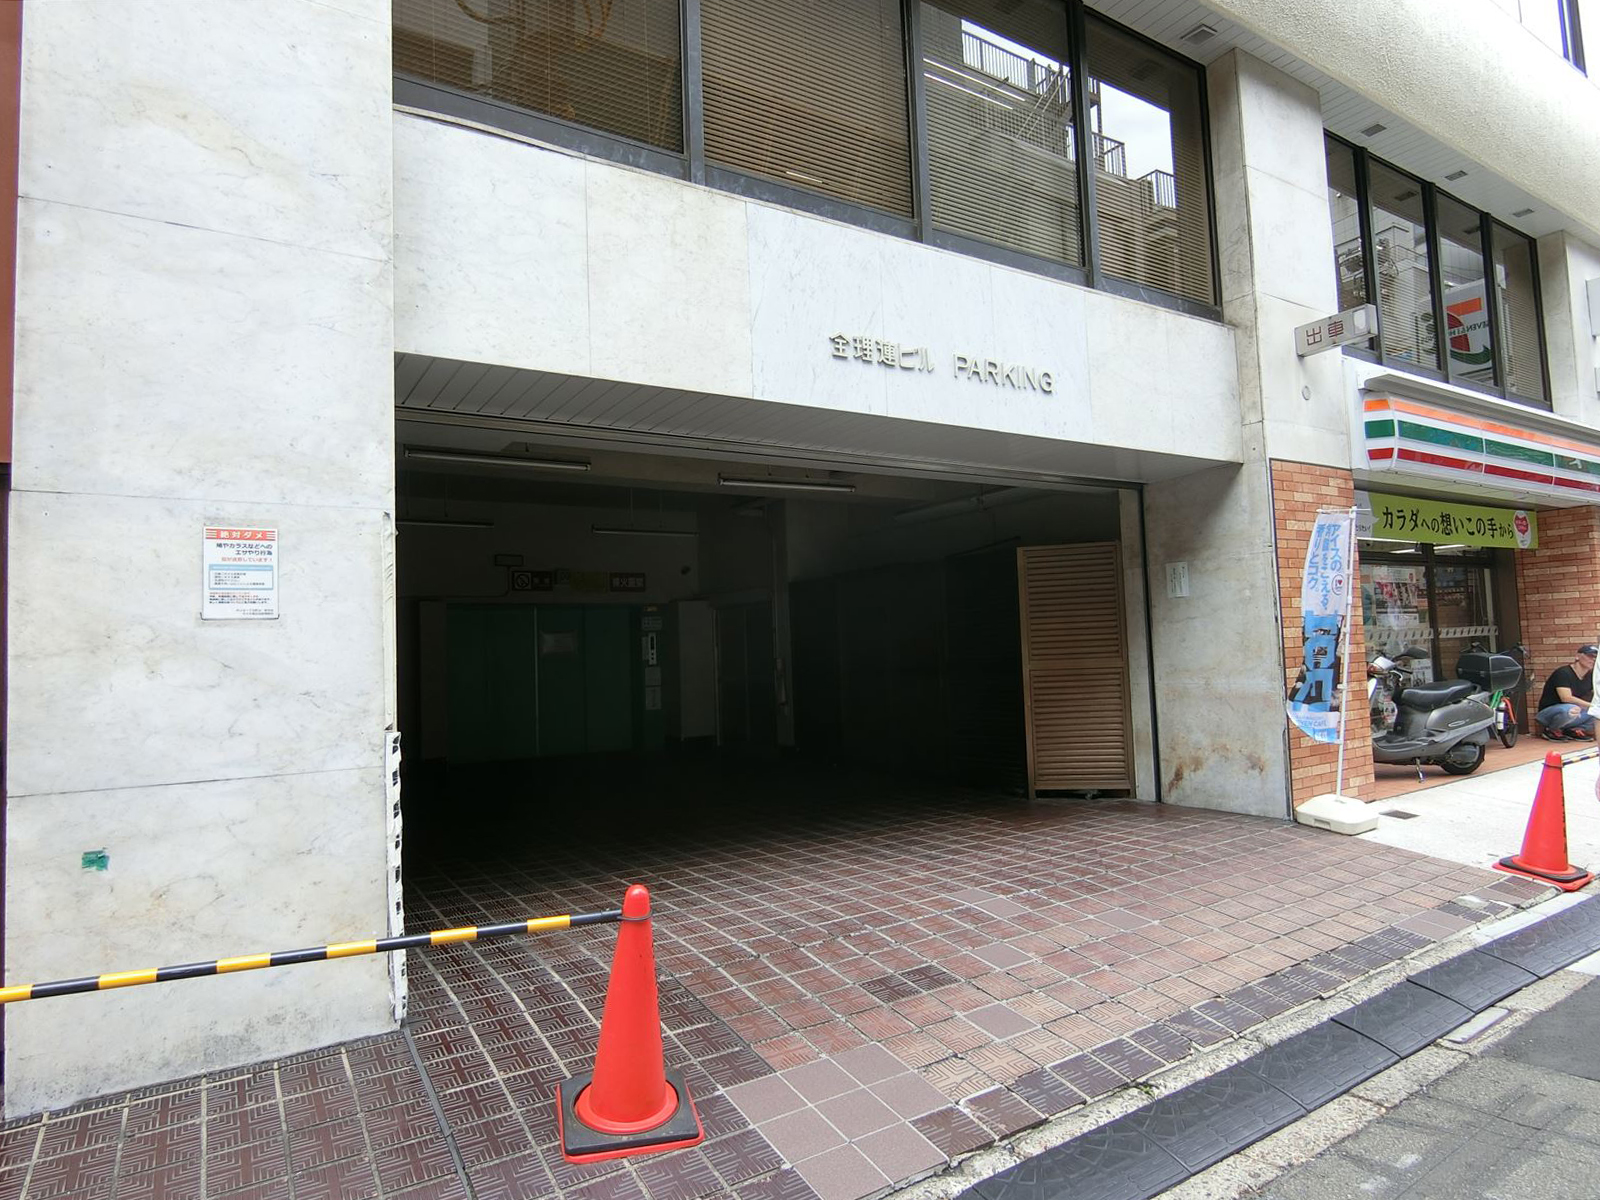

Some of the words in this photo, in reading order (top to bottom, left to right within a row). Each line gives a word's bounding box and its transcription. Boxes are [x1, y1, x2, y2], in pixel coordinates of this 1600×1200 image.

[1306, 319, 1344, 346] 出車
[829, 332, 934, 373] 全理連ビル
[953, 353, 1054, 395] PARKING
[1382, 506, 1514, 540] カラダへの想いこの手から
[1330, 524, 1342, 571] アイスの
